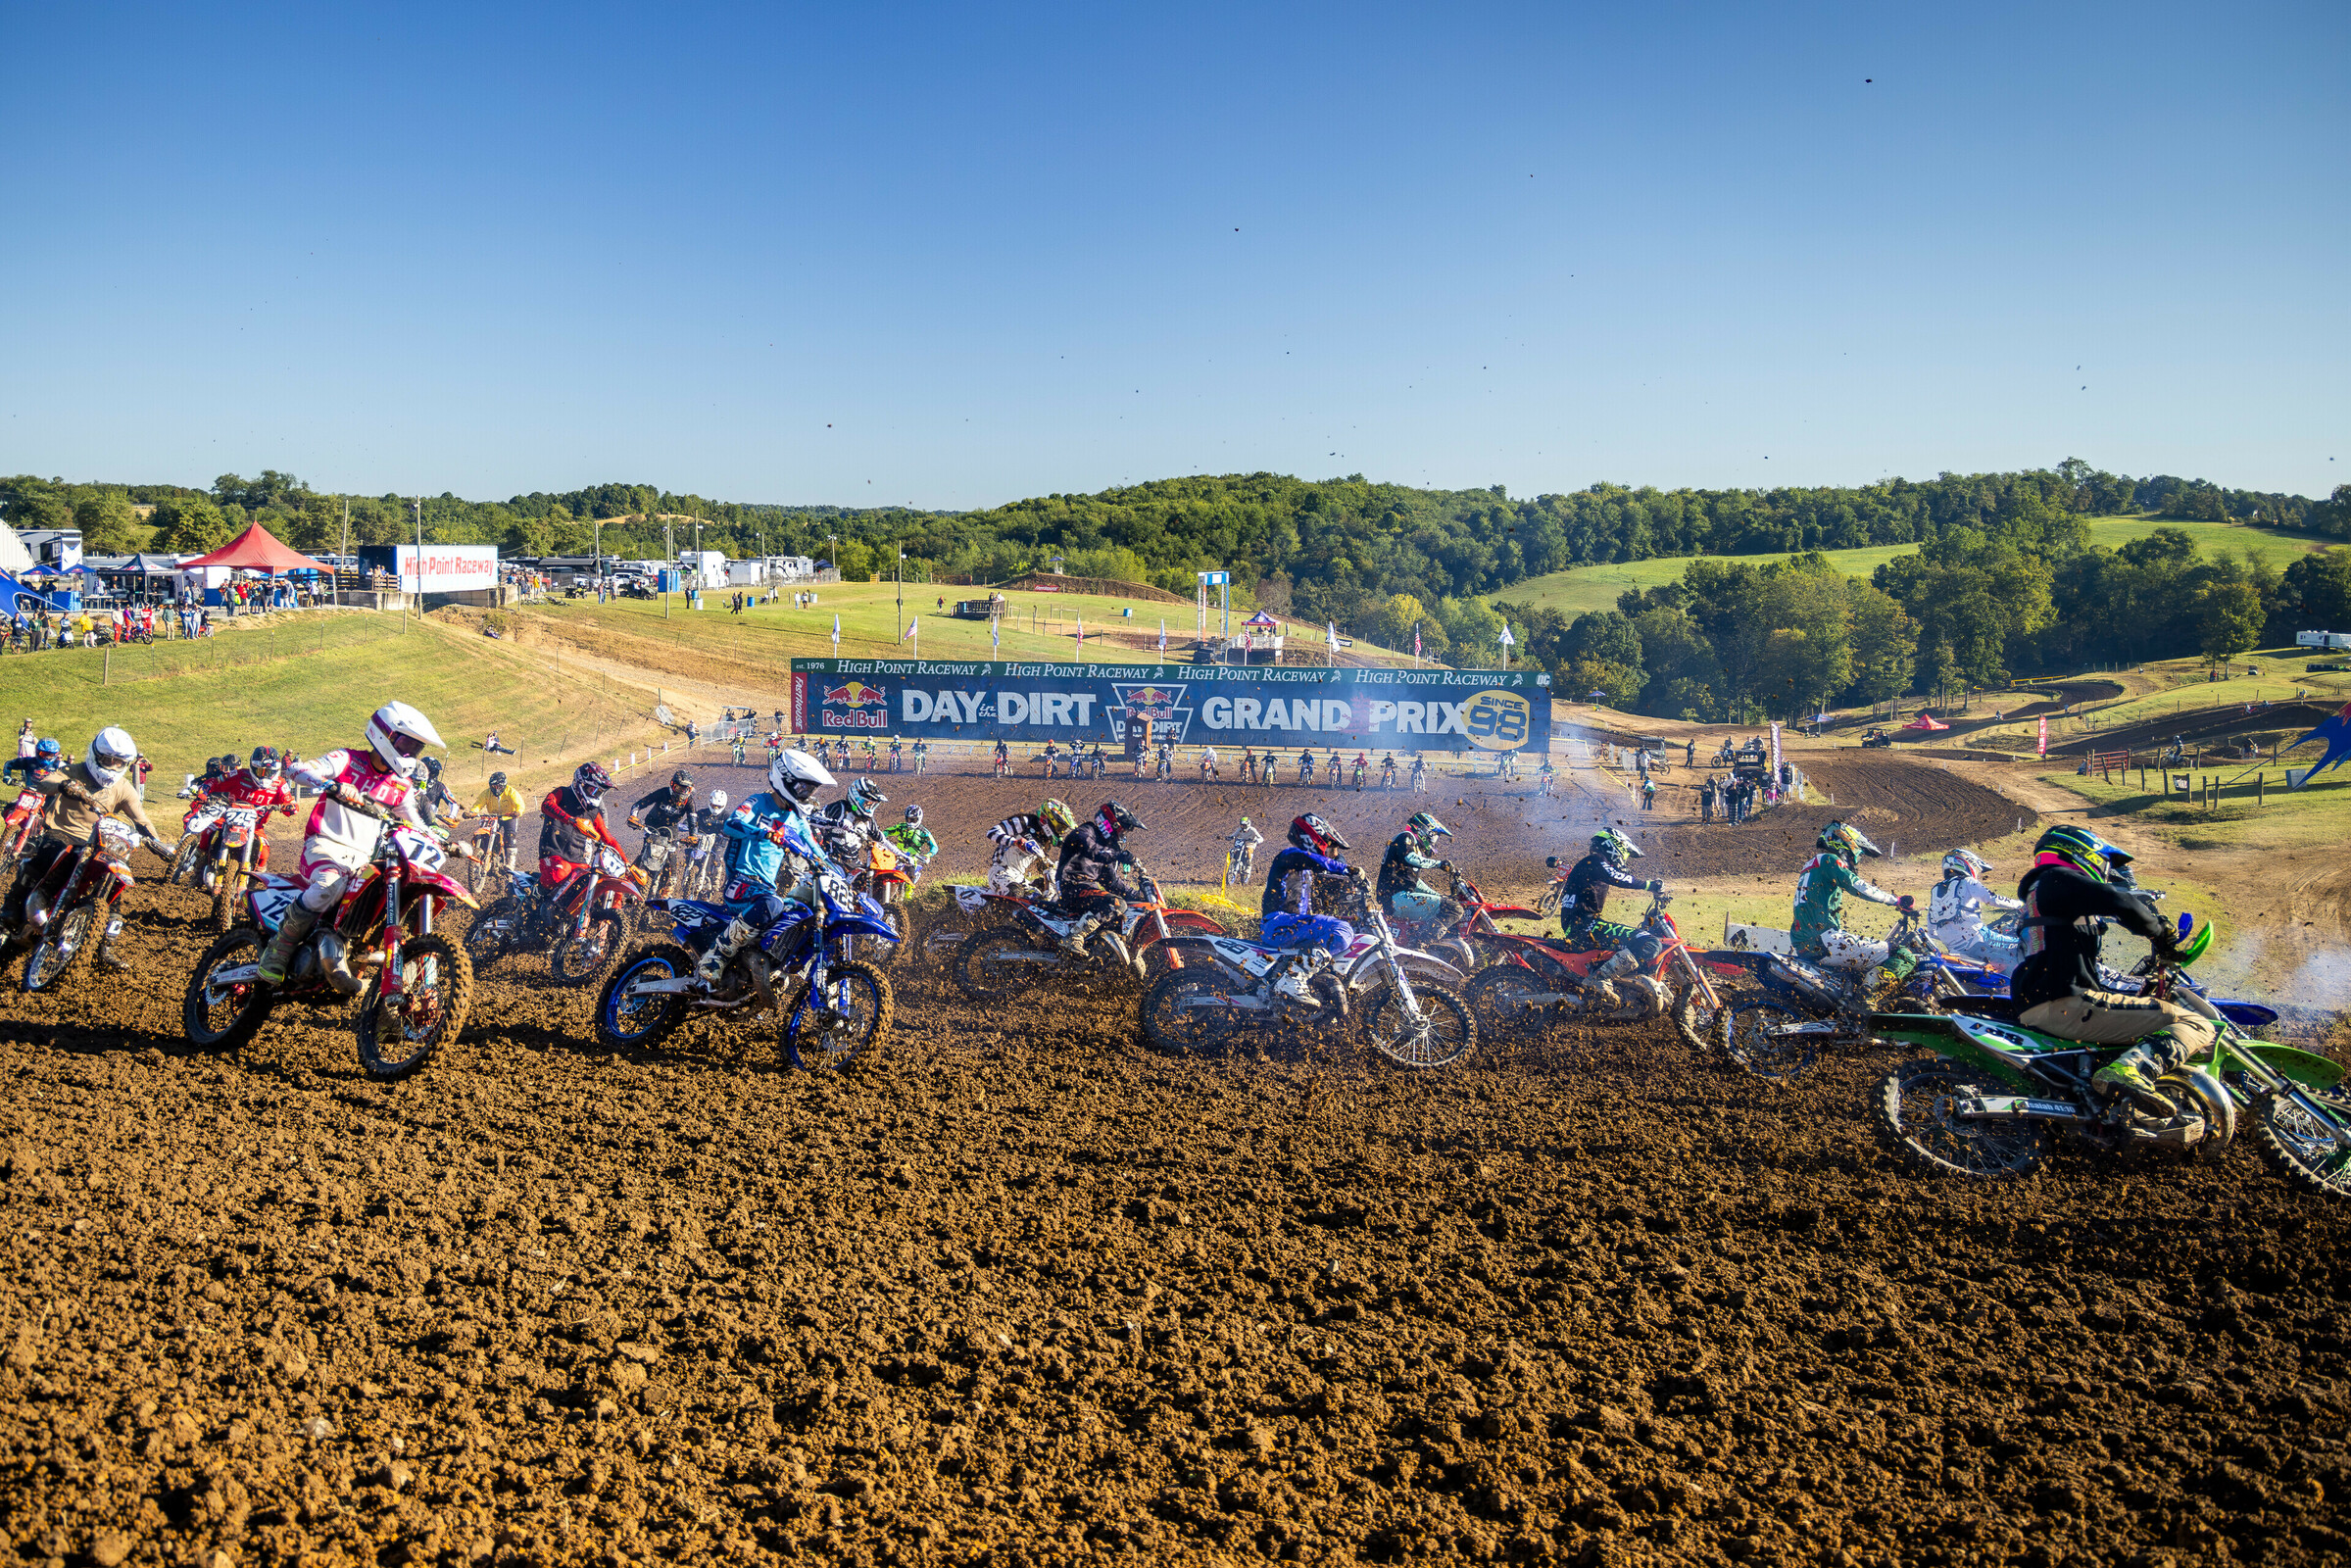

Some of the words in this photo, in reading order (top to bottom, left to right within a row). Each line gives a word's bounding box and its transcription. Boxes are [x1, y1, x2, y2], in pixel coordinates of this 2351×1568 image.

[428, 557, 454, 575] Point
[455, 557, 495, 576] Raceway
[836, 660, 871, 673] HIGH
[874, 661, 915, 673] POINT
[916, 662, 978, 675] RACEWAY
[1004, 663, 1042, 676] HIGH
[1043, 663, 1086, 677] POINT
[1087, 664, 1150, 678] RACEWAY
[1177, 665, 1215, 680] HIGH
[1216, 666, 1260, 681] POINT
[1262, 667, 1327, 682] RACEWAY
[1354, 669, 1394, 683] HIGH
[1396, 670, 1441, 684] POINT
[1442, 671, 1508, 686] RACEWAY
[795, 676, 804, 730] FASTHOUSE
[902, 689, 987, 723] DAY
[980, 703, 997, 711] in
[997, 691, 1097, 726] DIRT
[1480, 696, 1525, 710] SINCE
[822, 709, 856, 727] Red
[856, 709, 888, 727] Bull
[1151, 707, 1173, 719] Bull
[1202, 696, 1352, 732] GRAND
[1368, 700, 1470, 735] PRIX
[1468, 705, 1527, 742] 98
[775, 757, 795, 783] 100%
[408, 837, 442, 872] 72
[260, 895, 292, 921] 72
[1592, 921, 1636, 938] FXR
[2026, 1101, 2054, 1112] Isaiah
[2054, 1102, 2077, 1113] 41:10
